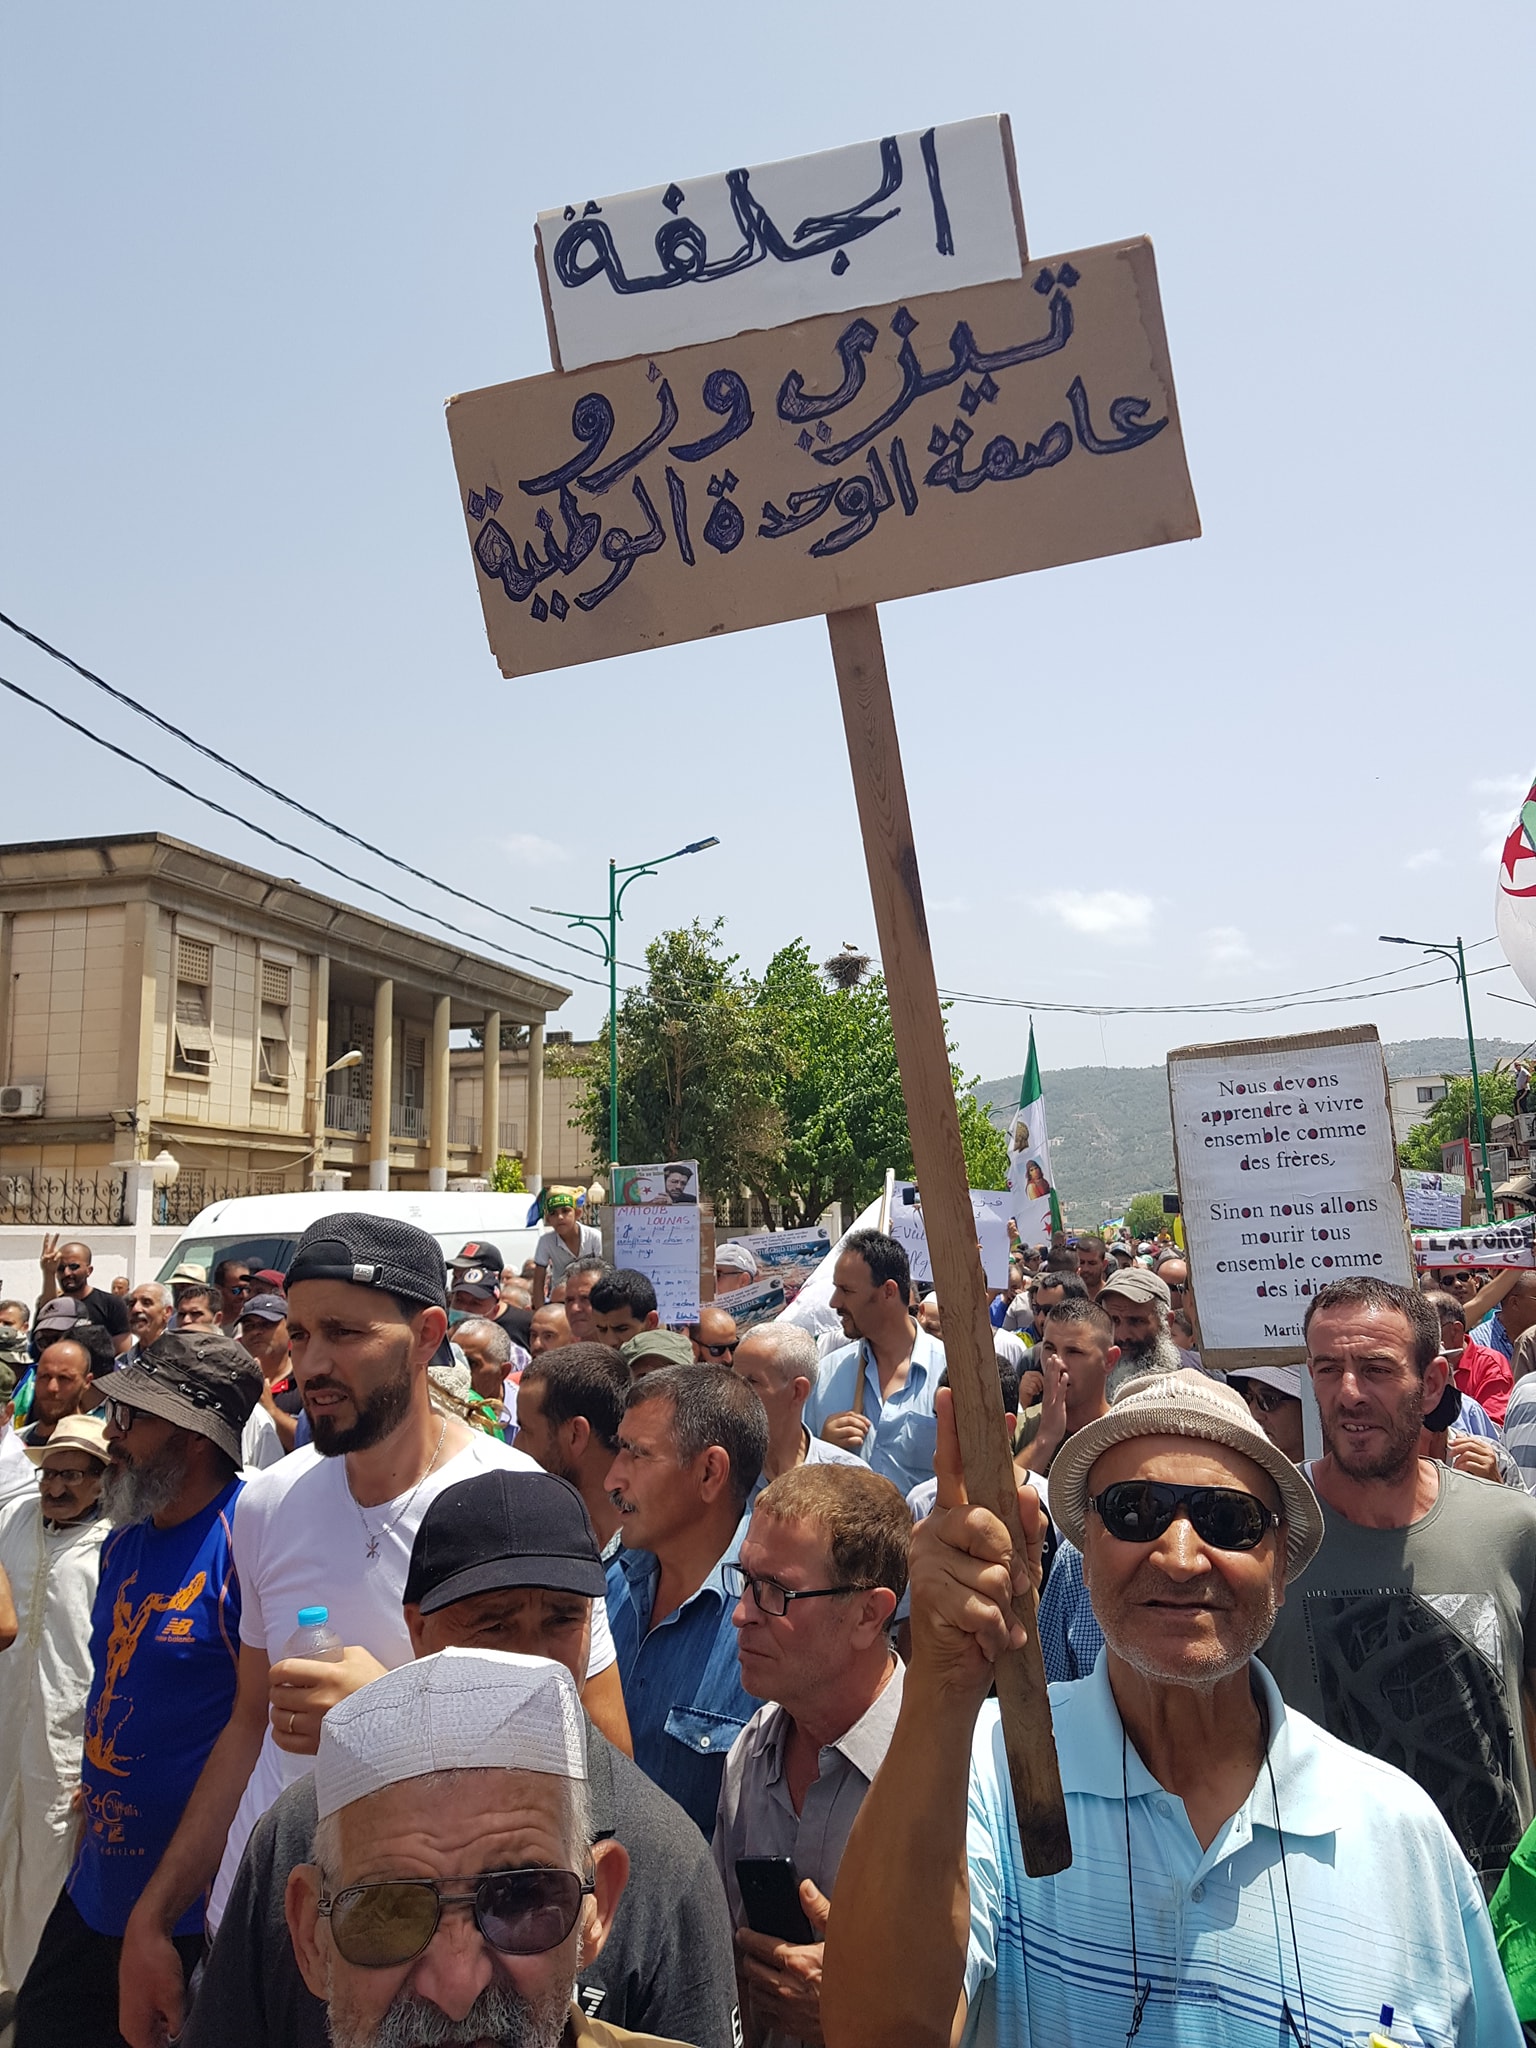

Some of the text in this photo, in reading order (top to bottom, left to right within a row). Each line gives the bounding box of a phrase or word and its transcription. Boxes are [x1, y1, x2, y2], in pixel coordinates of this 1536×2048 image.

[554, 127, 955, 295] الجلفة
[777, 262, 1081, 465] تيزي
[467, 375, 1170, 622] عاصمة الوحدة الوطنية
[1217, 1074, 1339, 1097] Nous devons
[1201, 1096, 1364, 1127] apprendre à vivre
[1204, 1123, 1367, 1148] ensemble comme
[1240, 1150, 1336, 1171] des frères,
[617, 1206, 668, 1216] MATOUB
[1210, 1197, 1378, 1221] Sinon nous allons
[647, 1216, 690, 1226] LOUNAS
[1241, 1225, 1351, 1246] mourir tous
[1429, 1237, 1468, 1251] LA
[1216, 1252, 1383, 1273] ensemble comme
[1256, 1281, 1288, 1298] des
[1306, 1590, 1328, 1598] LIFE
[167, 1634, 196, 1643] balance
